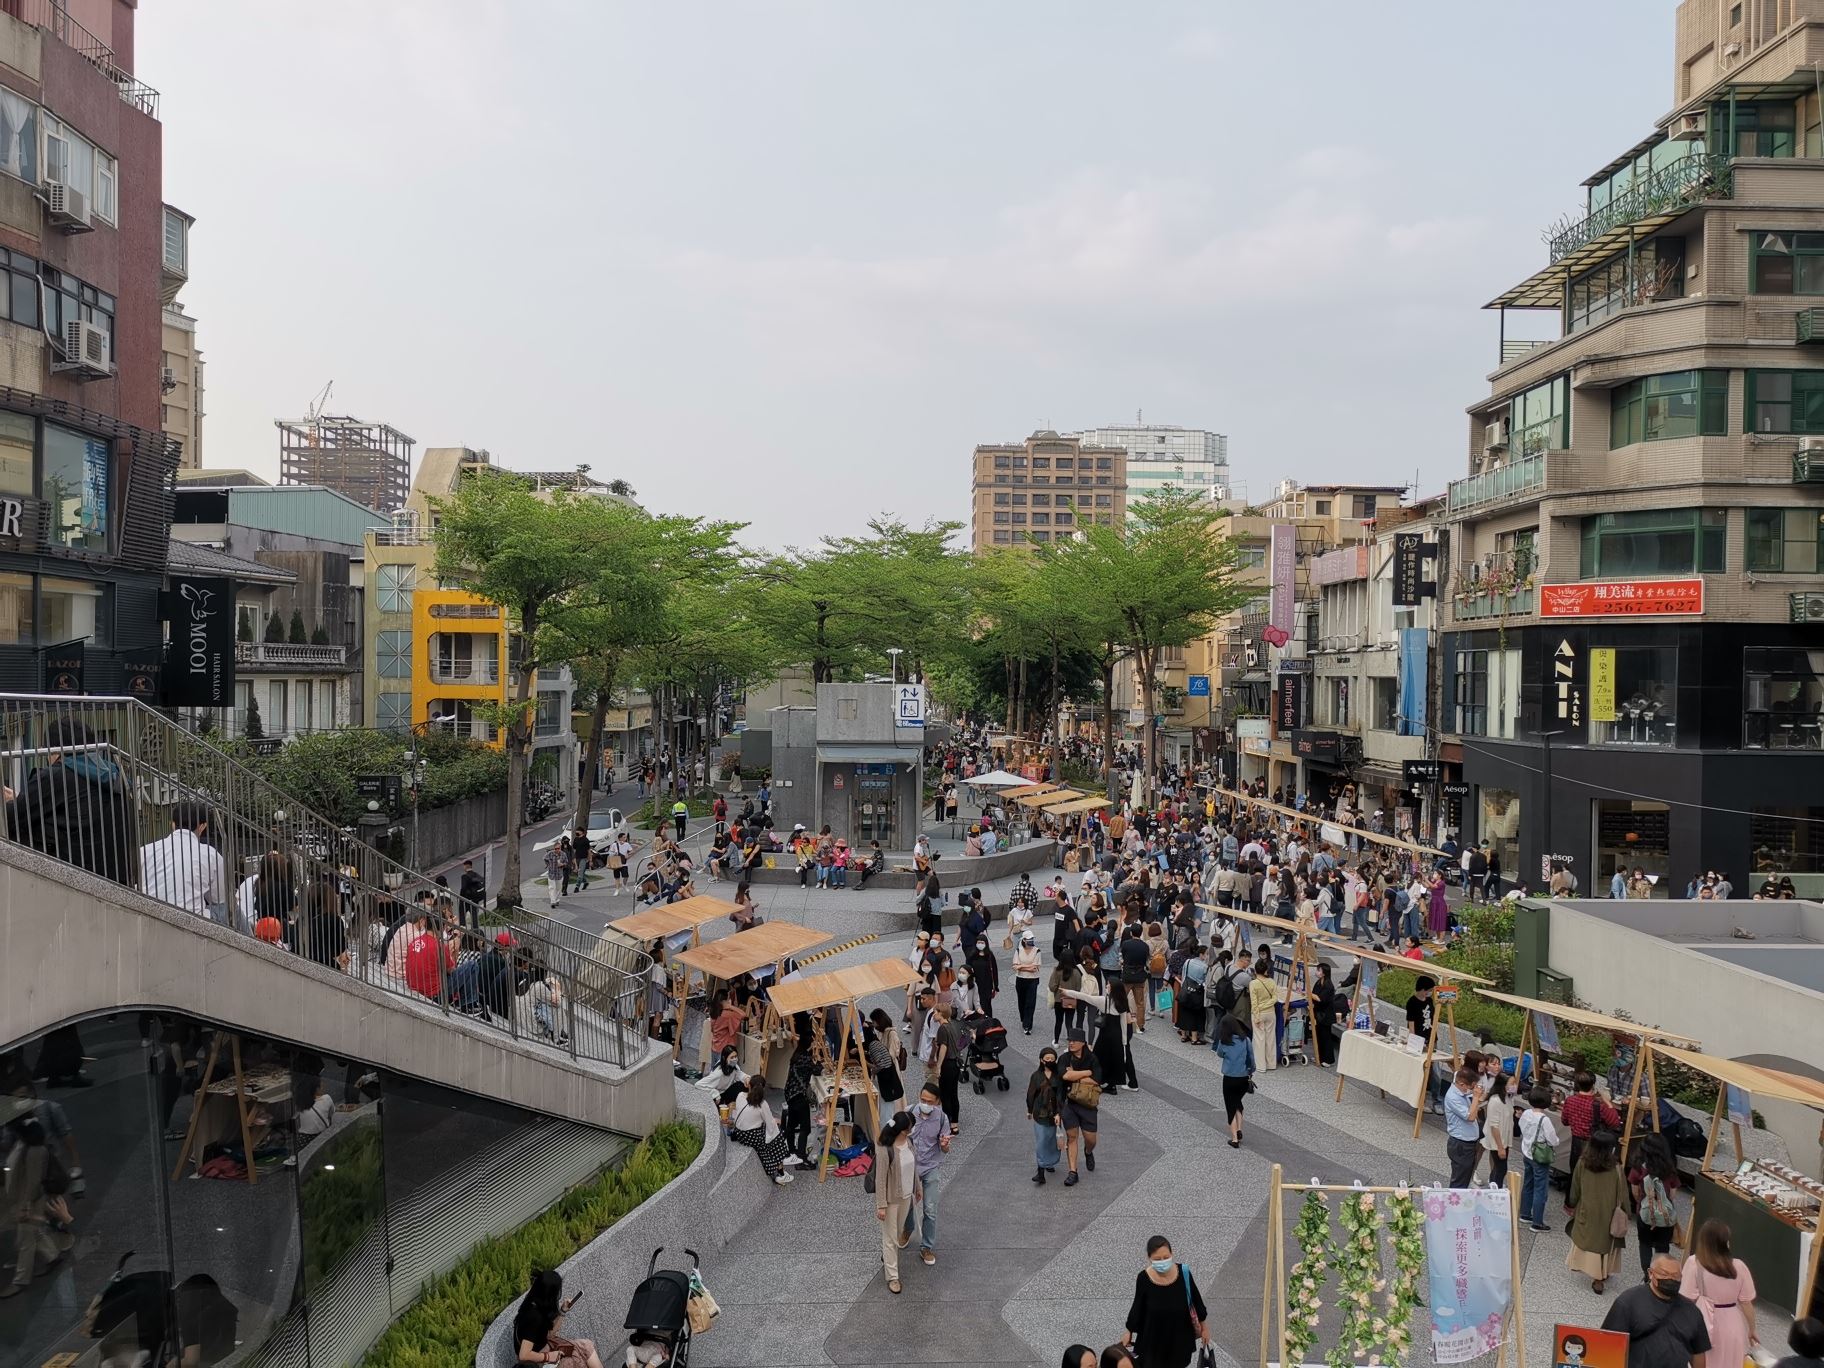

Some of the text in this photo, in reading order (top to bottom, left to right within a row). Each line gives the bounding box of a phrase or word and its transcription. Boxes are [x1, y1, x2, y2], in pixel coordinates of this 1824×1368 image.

[1604, 600, 1696, 613] 2567-7627
[190, 622, 207, 675] MOOI
[213, 653, 221, 701] HAIR SALON
[1554, 639, 1575, 718] ANTI
[1284, 679, 1295, 727] aimerfeel
[1572, 691, 1580, 727] SALON
